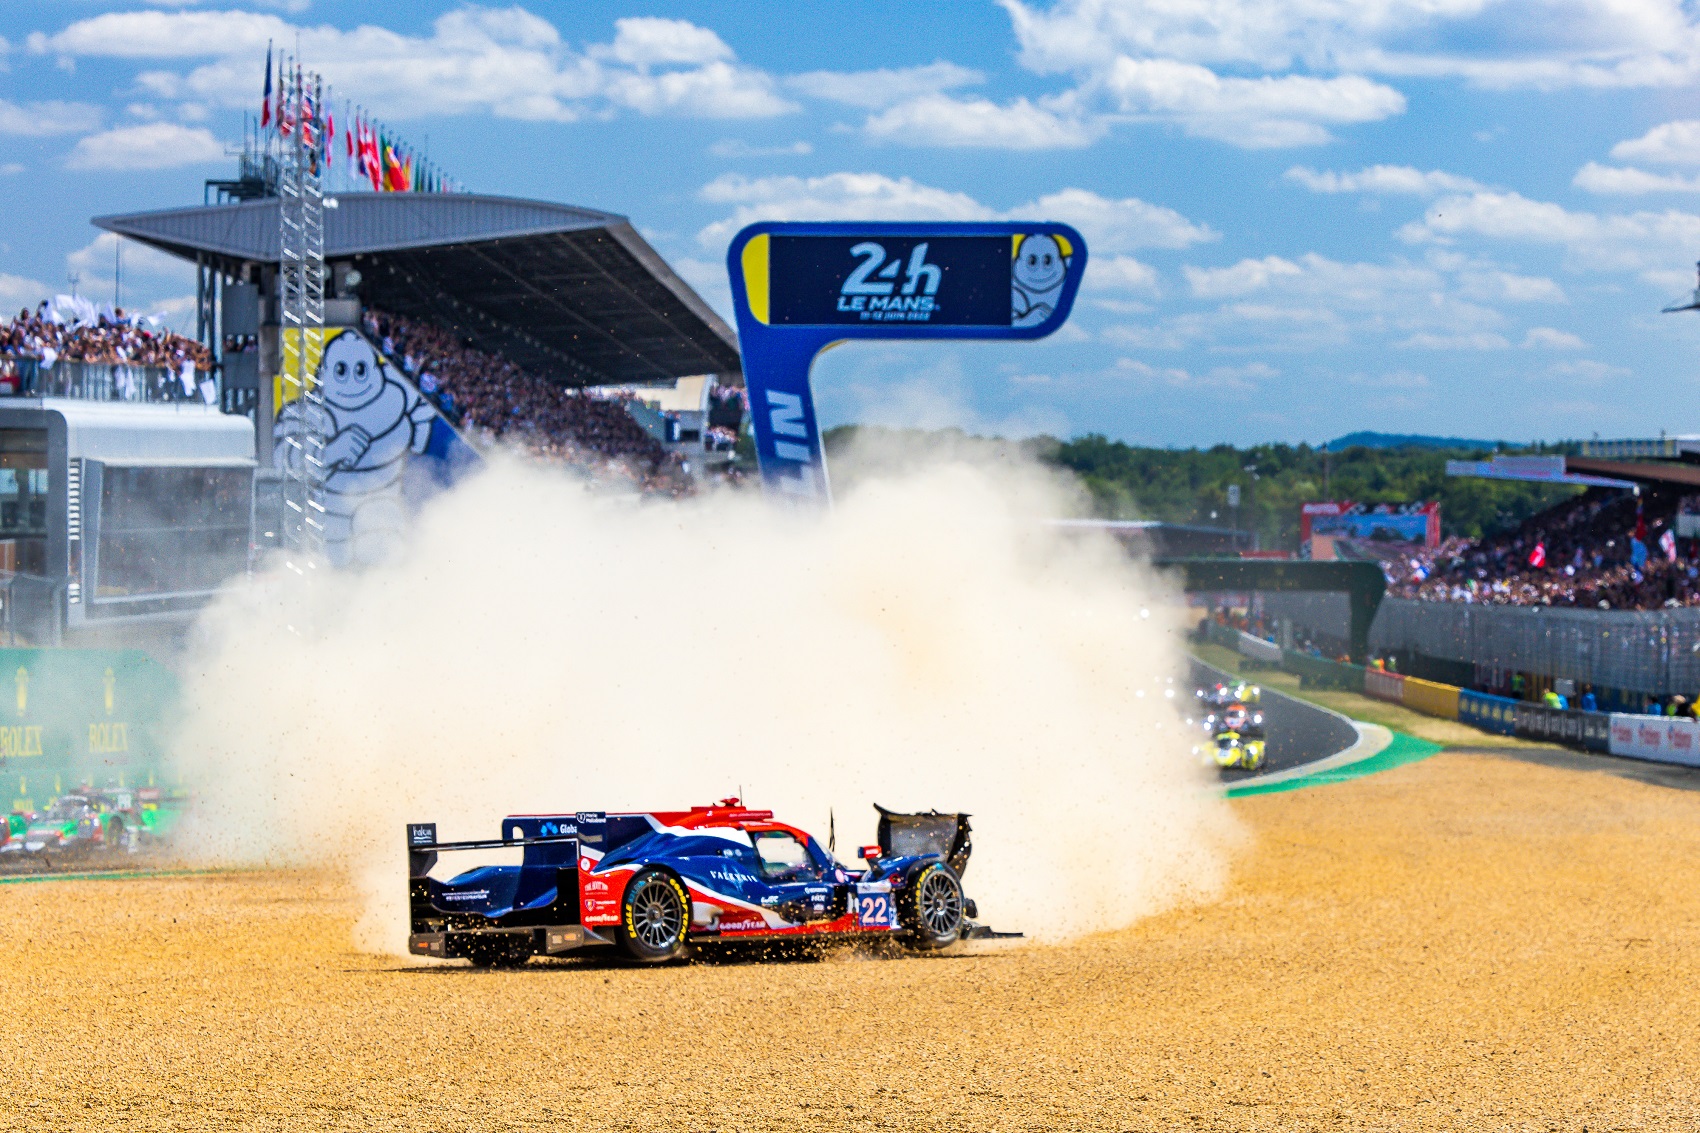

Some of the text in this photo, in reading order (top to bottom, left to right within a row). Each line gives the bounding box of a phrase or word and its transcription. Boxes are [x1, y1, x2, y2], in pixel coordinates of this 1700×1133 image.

[841, 241, 942, 295] 24h
[837, 296, 935, 311] LE MANS
[89, 723, 128, 752] ROLEX
[861, 897, 888, 923] 22
[719, 919, 766, 930] GOODYEAR
